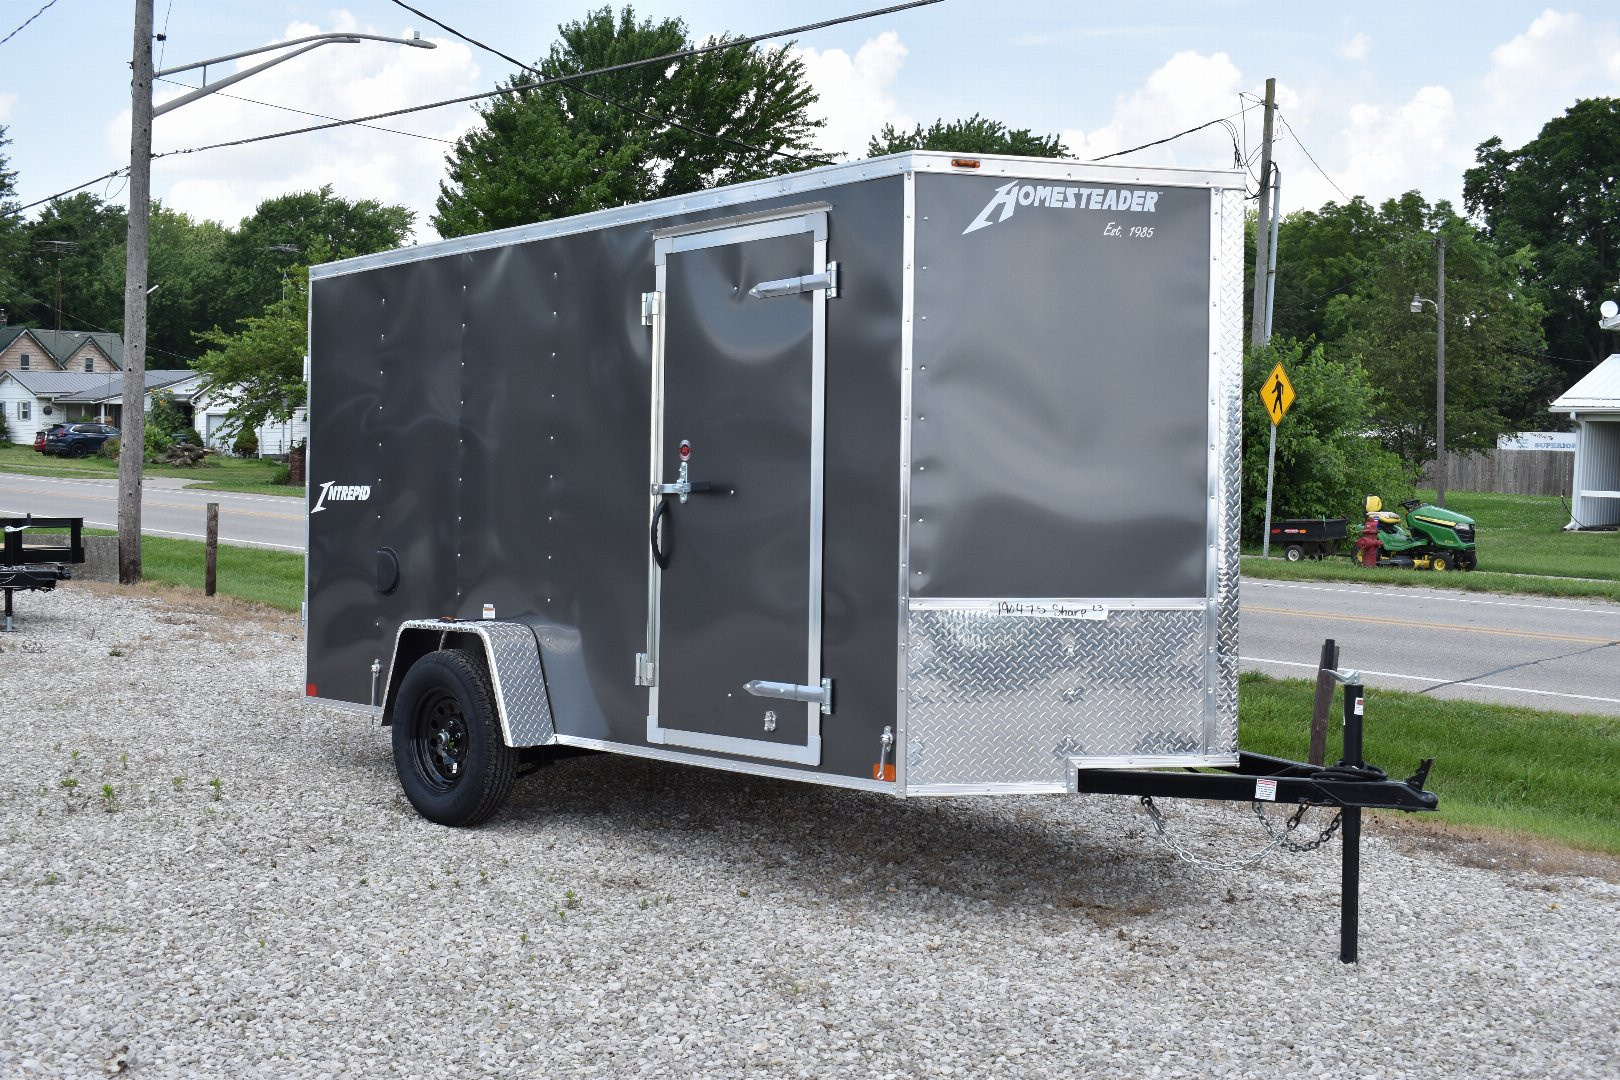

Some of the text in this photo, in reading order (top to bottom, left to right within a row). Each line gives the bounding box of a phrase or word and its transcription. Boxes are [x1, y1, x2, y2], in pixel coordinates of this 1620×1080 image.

[962, 179, 1160, 235] HOMESTEADER
[1103, 221, 1155, 238] Est. 1985
[310, 480, 371, 513] INTREPID
[1052, 603, 1087, 618] Sharp
